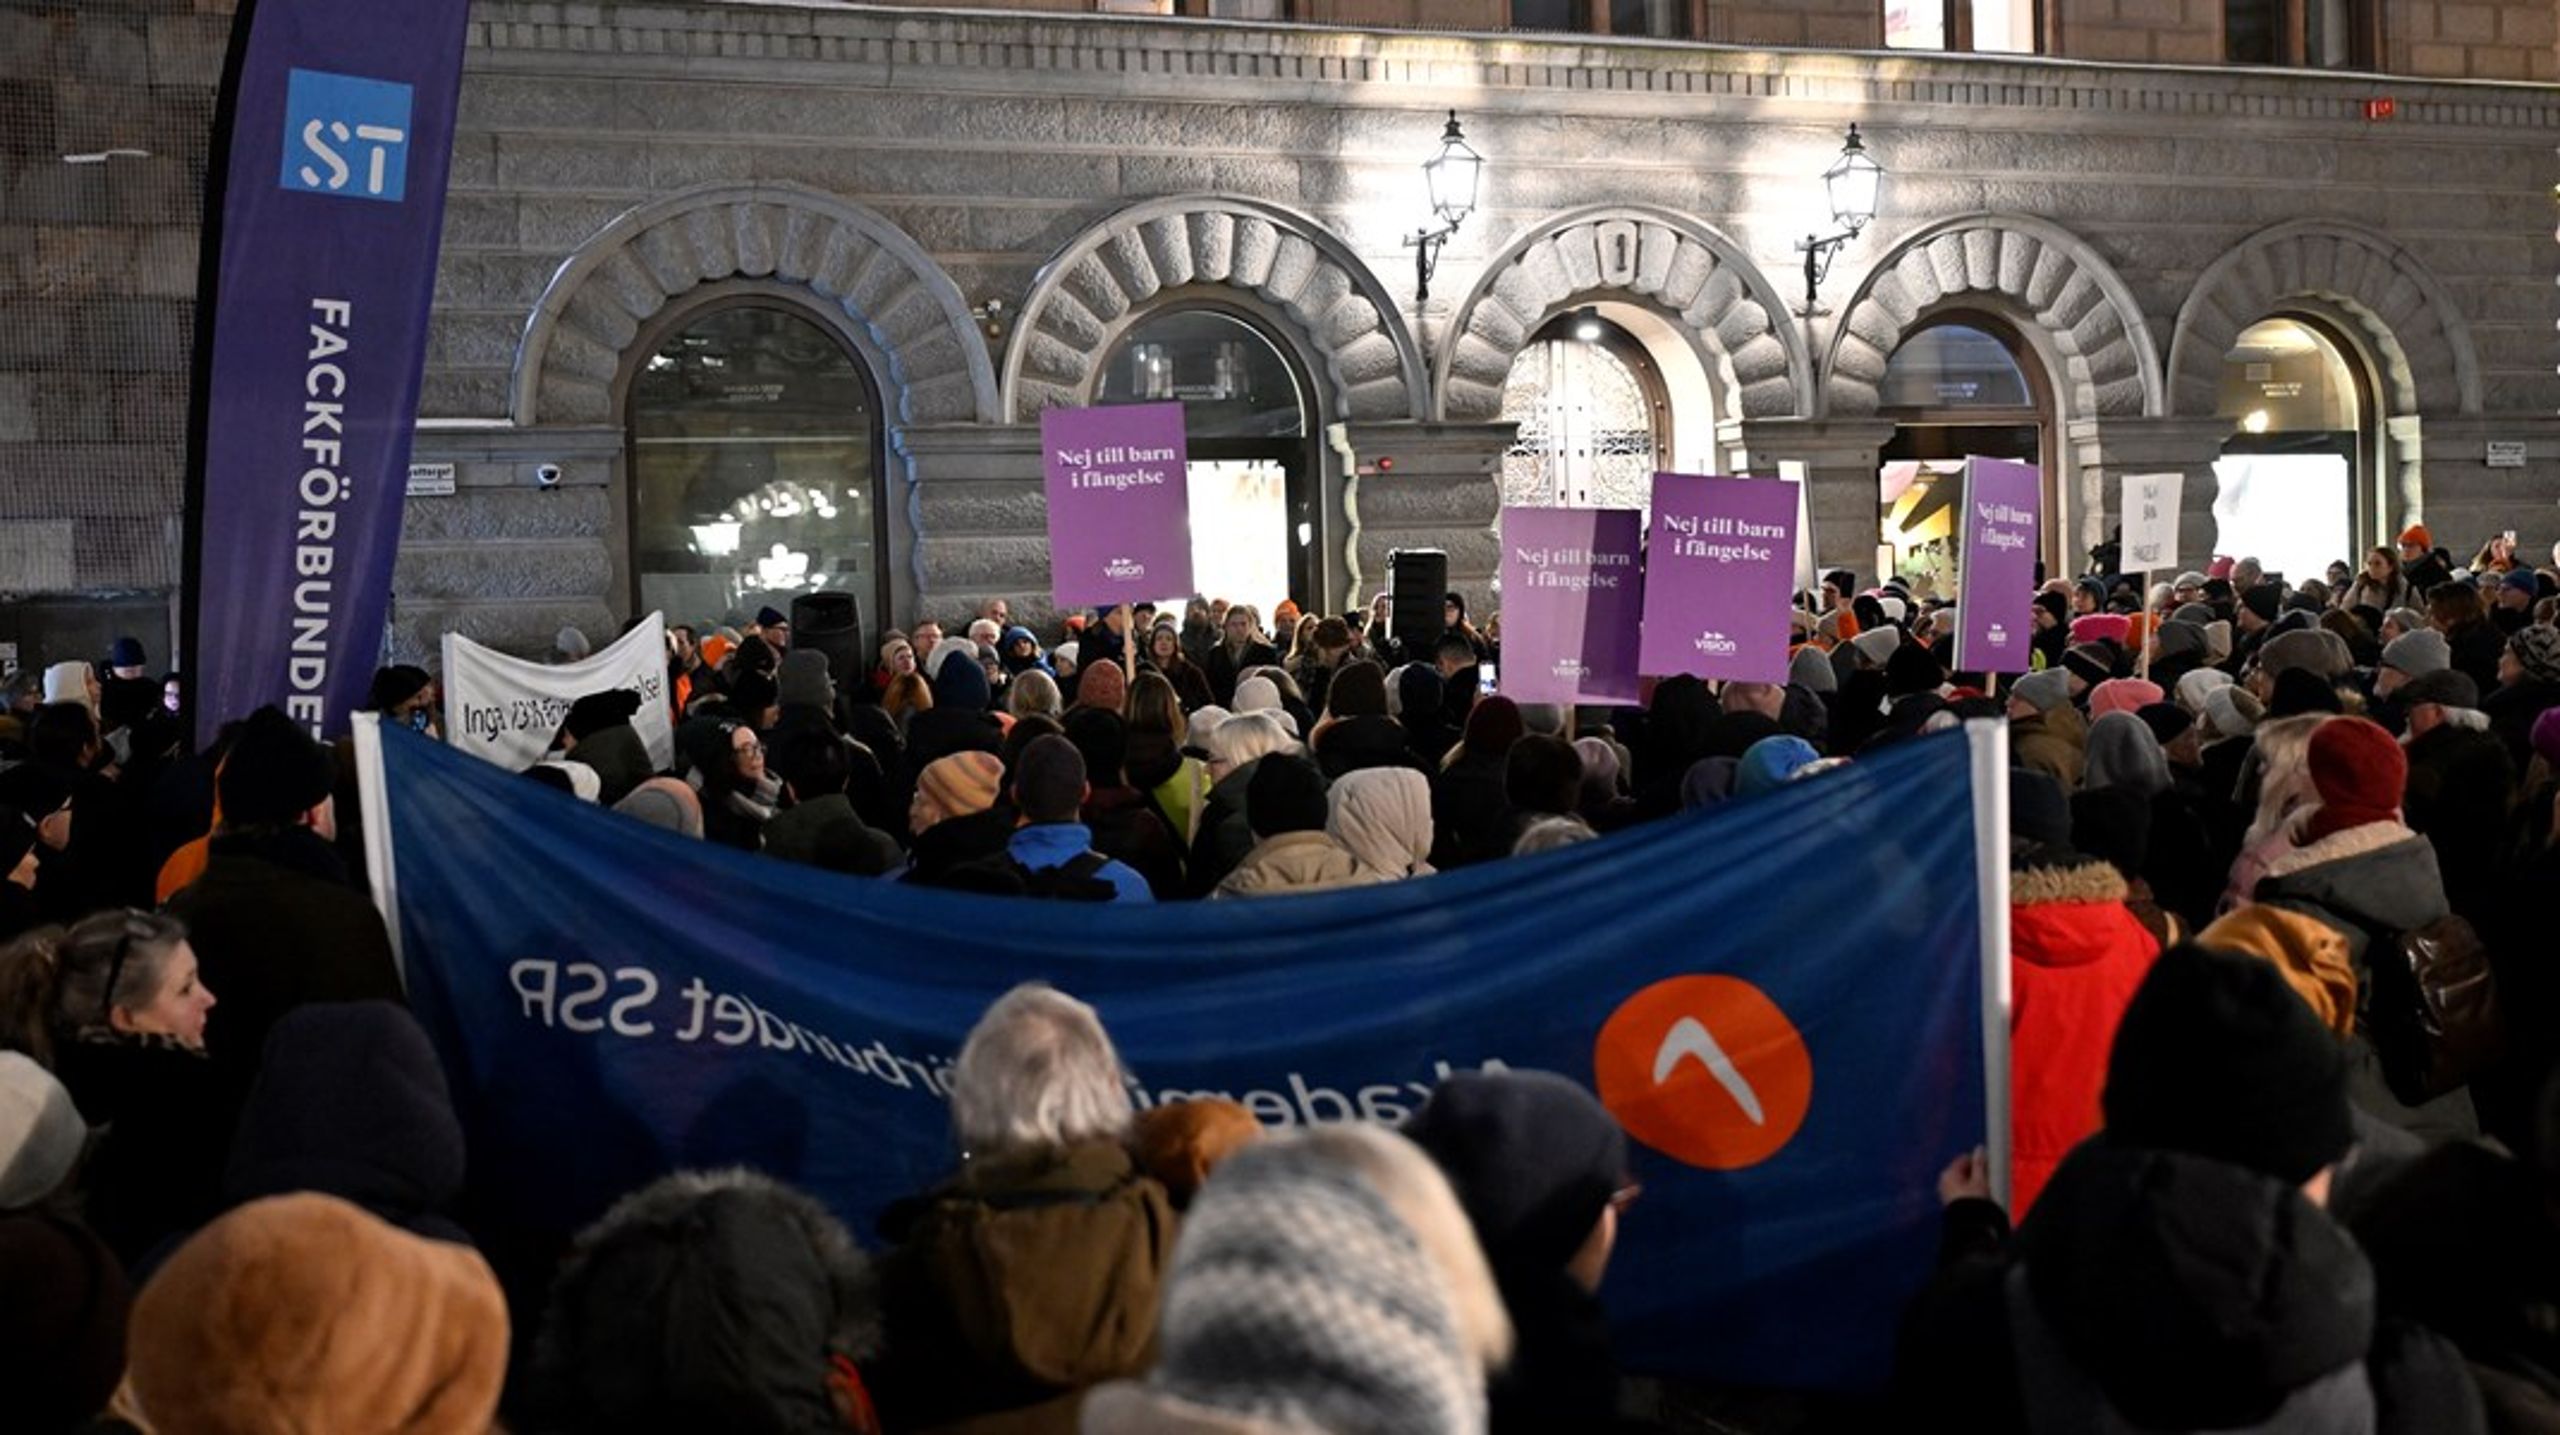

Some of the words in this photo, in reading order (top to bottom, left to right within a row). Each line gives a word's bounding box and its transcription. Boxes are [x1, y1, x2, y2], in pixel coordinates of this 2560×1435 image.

[301, 119, 404, 194] ST
[1058, 448, 1092, 469] Nej
[1096, 447, 1124, 464] till
[1128, 446, 1175, 462] barn
[1071, 472, 1079, 489] i
[1083, 468, 1165, 491] fängelse
[1664, 515, 1698, 537] Nej
[1703, 516, 1732, 537] till
[1738, 519, 1786, 539] barn
[1515, 548, 1549, 567] Nej
[1553, 549, 1581, 565] till
[1585, 550, 1631, 565] barn
[1674, 538, 1681, 555] i
[1685, 538, 1771, 562] fängelse
[1528, 571, 1534, 586] i
[1538, 570, 1619, 592] fängelse
[1694, 636, 1736, 652] vision
[463, 703, 507, 742] Inga
